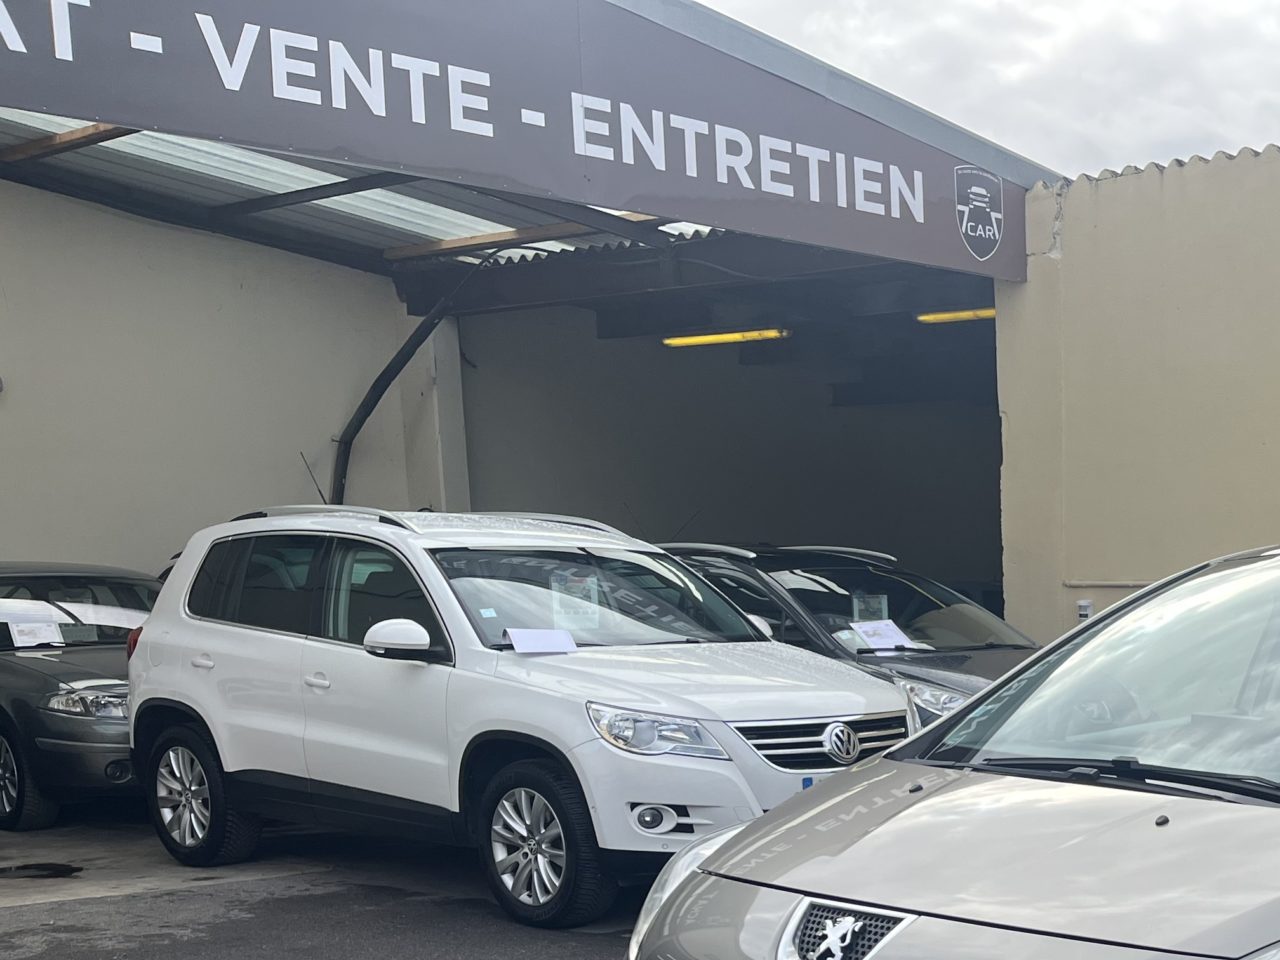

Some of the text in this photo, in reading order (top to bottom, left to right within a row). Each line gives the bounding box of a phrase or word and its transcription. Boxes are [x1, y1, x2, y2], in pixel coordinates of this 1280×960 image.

[130, 31, 163, 53] -
[195, 13, 494, 138] VENTE
[521, 109, 546, 127] -
[570, 92, 925, 223] ENTRETIEN
